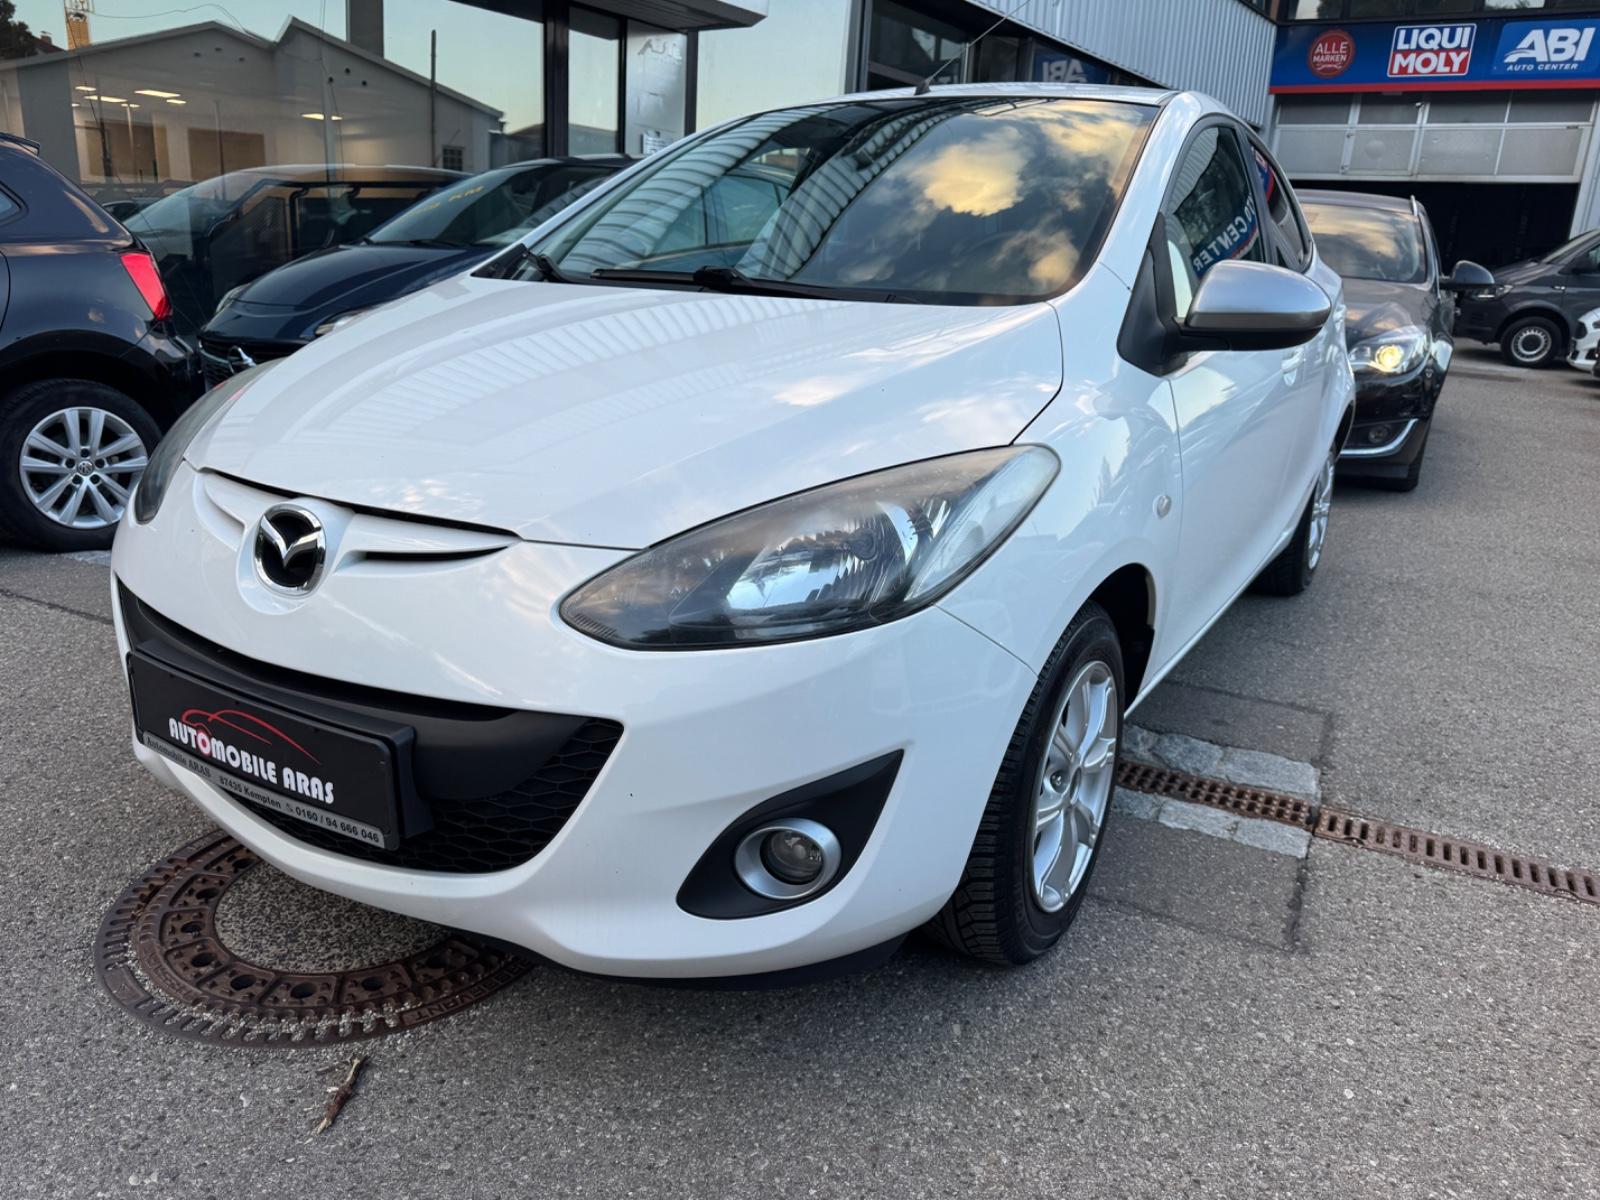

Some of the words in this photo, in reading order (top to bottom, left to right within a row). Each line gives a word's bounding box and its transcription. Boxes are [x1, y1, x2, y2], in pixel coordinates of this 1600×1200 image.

[1314, 41, 1349, 55] ALLE
[1396, 26, 1472, 50] LIQUI
[1503, 27, 1596, 63] ABI
[1312, 54, 1348, 63] MARKEN
[1392, 51, 1469, 74] MOLY
[1506, 64, 1534, 72] AUTO
[1537, 63, 1580, 71] CENTER
[168, 717, 278, 785] AUTOMOBILE
[282, 766, 335, 804] ARAS
[295, 807, 319, 822] 0160
[325, 816, 338, 829] 94
[340, 821, 359, 836] 666
[361, 830, 380, 843] 046
